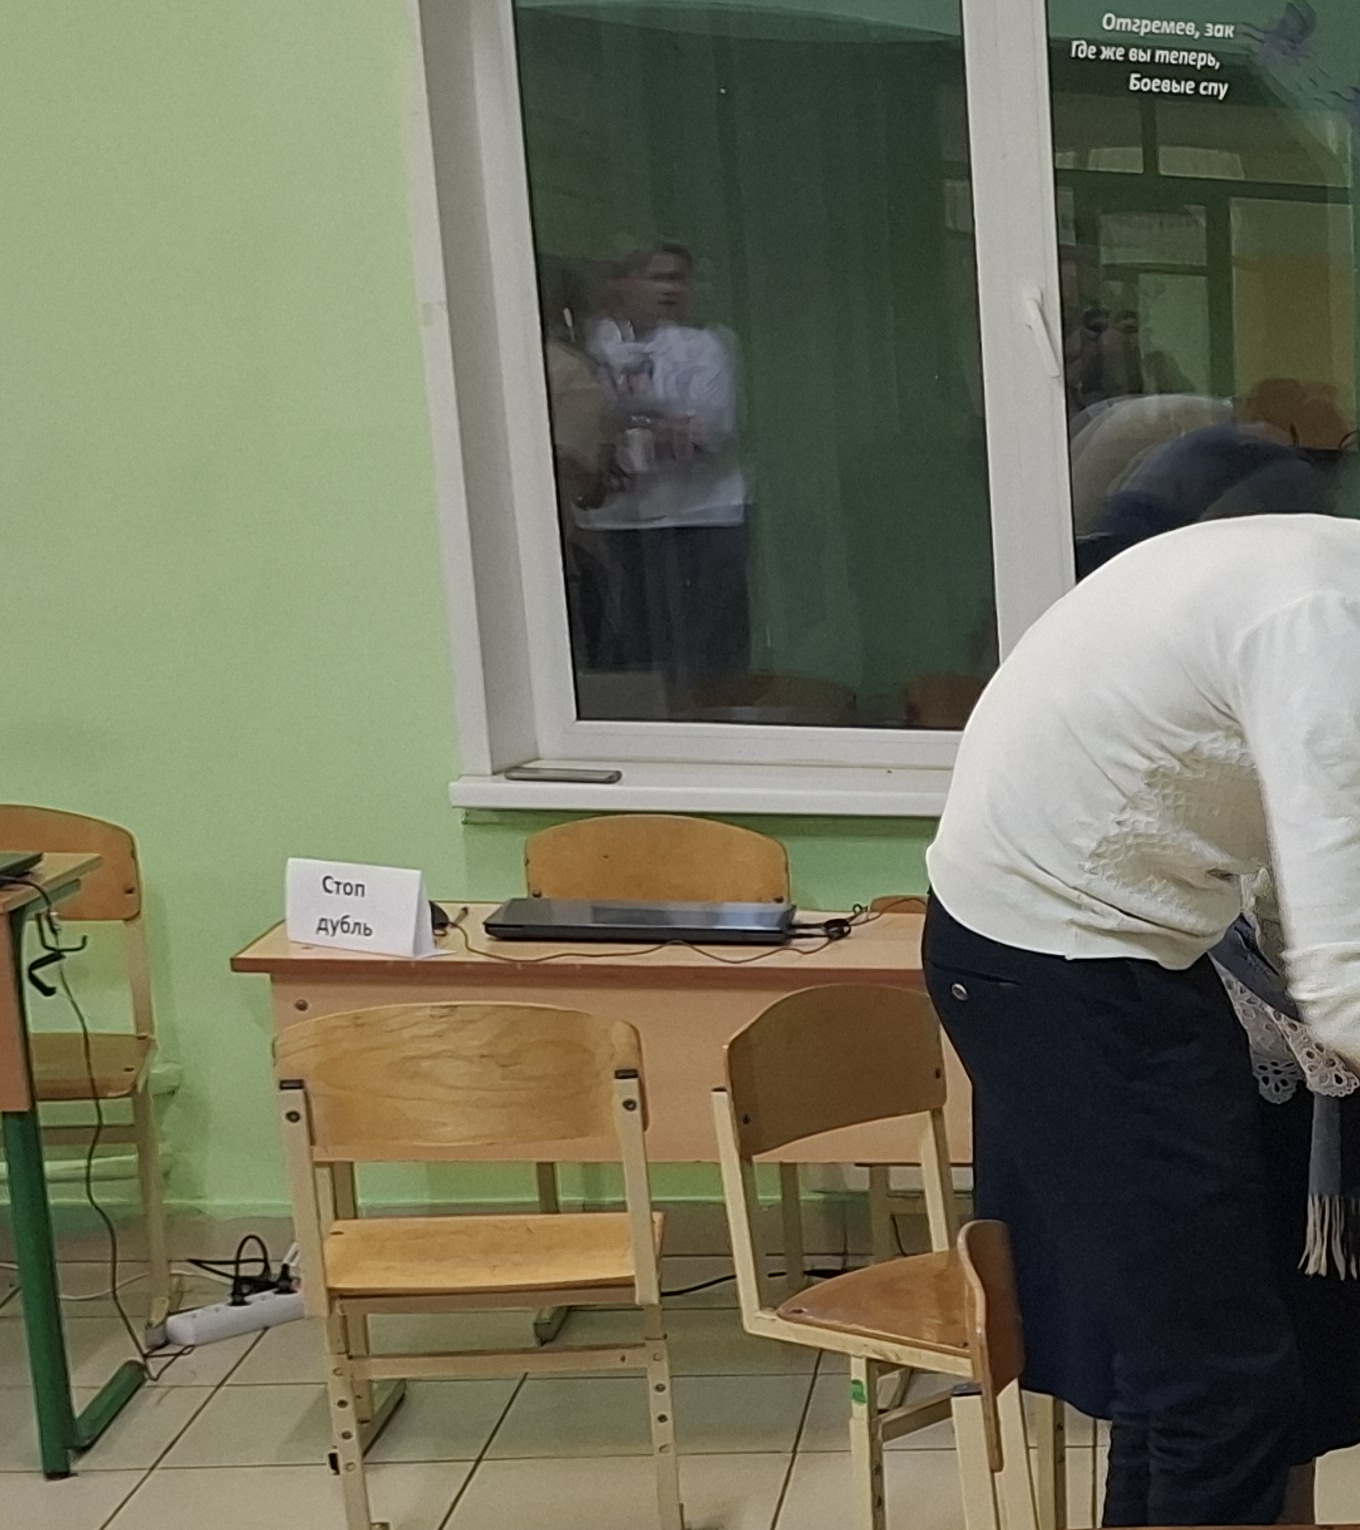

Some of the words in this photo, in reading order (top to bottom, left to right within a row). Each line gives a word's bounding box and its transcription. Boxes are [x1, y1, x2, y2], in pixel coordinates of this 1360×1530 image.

[1102, 12, 1200, 39] Отгремев,
[1204, 22, 1235, 38] зак
[1071, 40, 1097, 59] Где
[1099, 45, 1125, 61] же
[1128, 48, 1151, 62] вы
[1155, 49, 1220, 70] теперь,
[1129, 73, 1195, 94] Боевые
[1199, 81, 1229, 100] спу
[322, 875, 365, 897] Стоп
[315, 914, 373, 937] дубль
